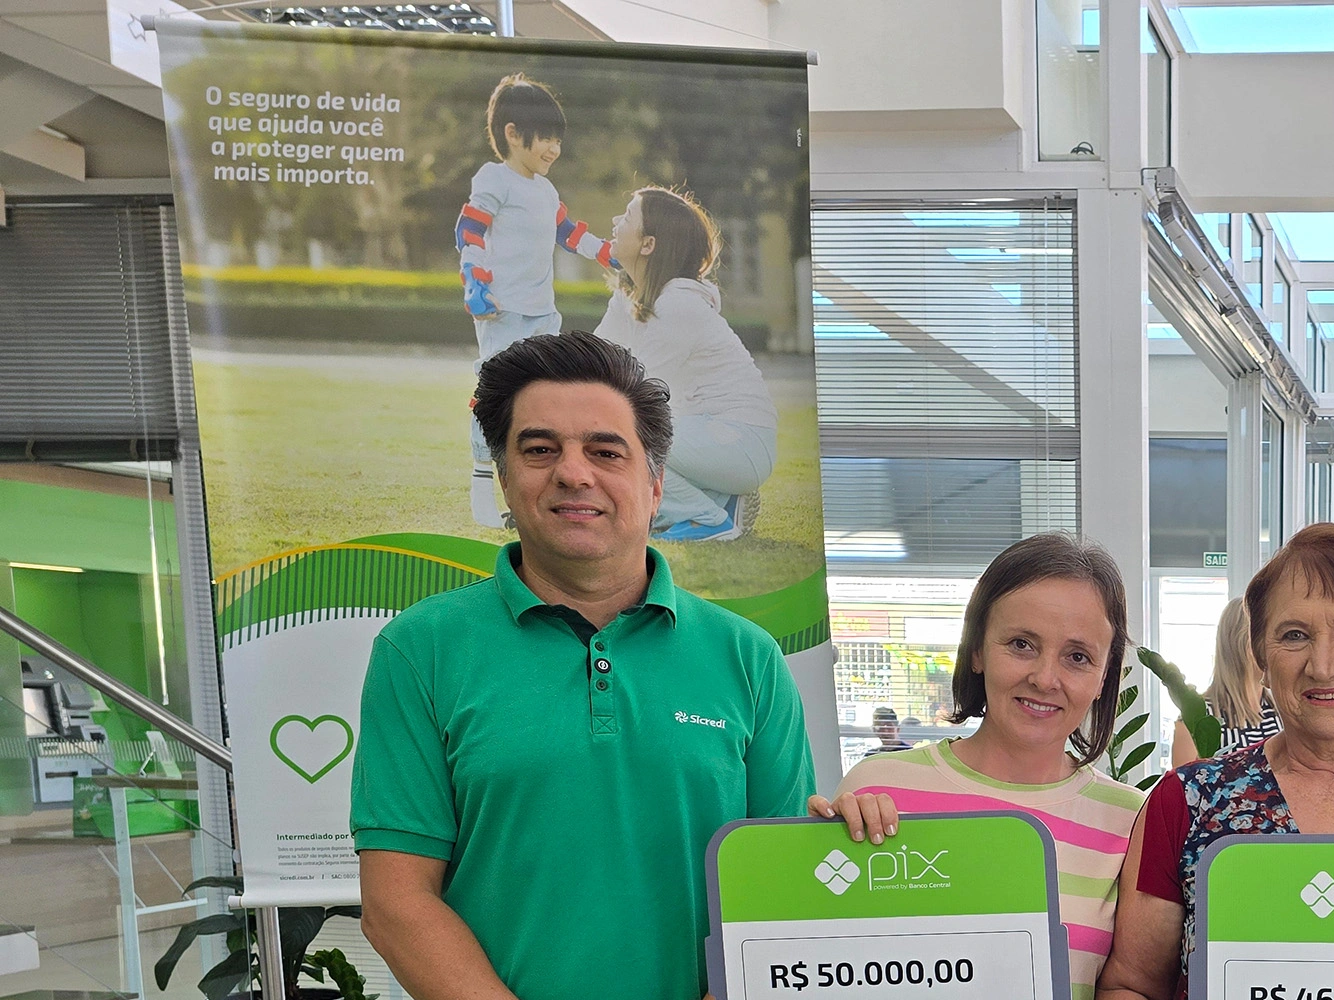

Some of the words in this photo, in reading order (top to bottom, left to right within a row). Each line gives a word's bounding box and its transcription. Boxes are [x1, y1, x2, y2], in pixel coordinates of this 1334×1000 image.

[205, 86, 222, 106] O
[228, 91, 310, 112] seguro
[316, 91, 345, 110] de
[350, 92, 401, 113] vida
[208, 115, 252, 135] que
[257, 113, 324, 137] ajuda
[329, 117, 384, 137] você
[211, 140, 225, 156] a
[232, 139, 336, 163] proteger
[341, 146, 405, 164] quem
[214, 162, 271, 182] mais
[276, 163, 375, 187] importa.
[1206, 554, 1227, 565] SAÍD
[690, 714, 727, 729] Sicredi
[276, 833, 333, 841] Intermediado
[867, 844, 950, 891] pix
[770, 961, 809, 991] R$
[817, 958, 974, 988] 50.000,00
